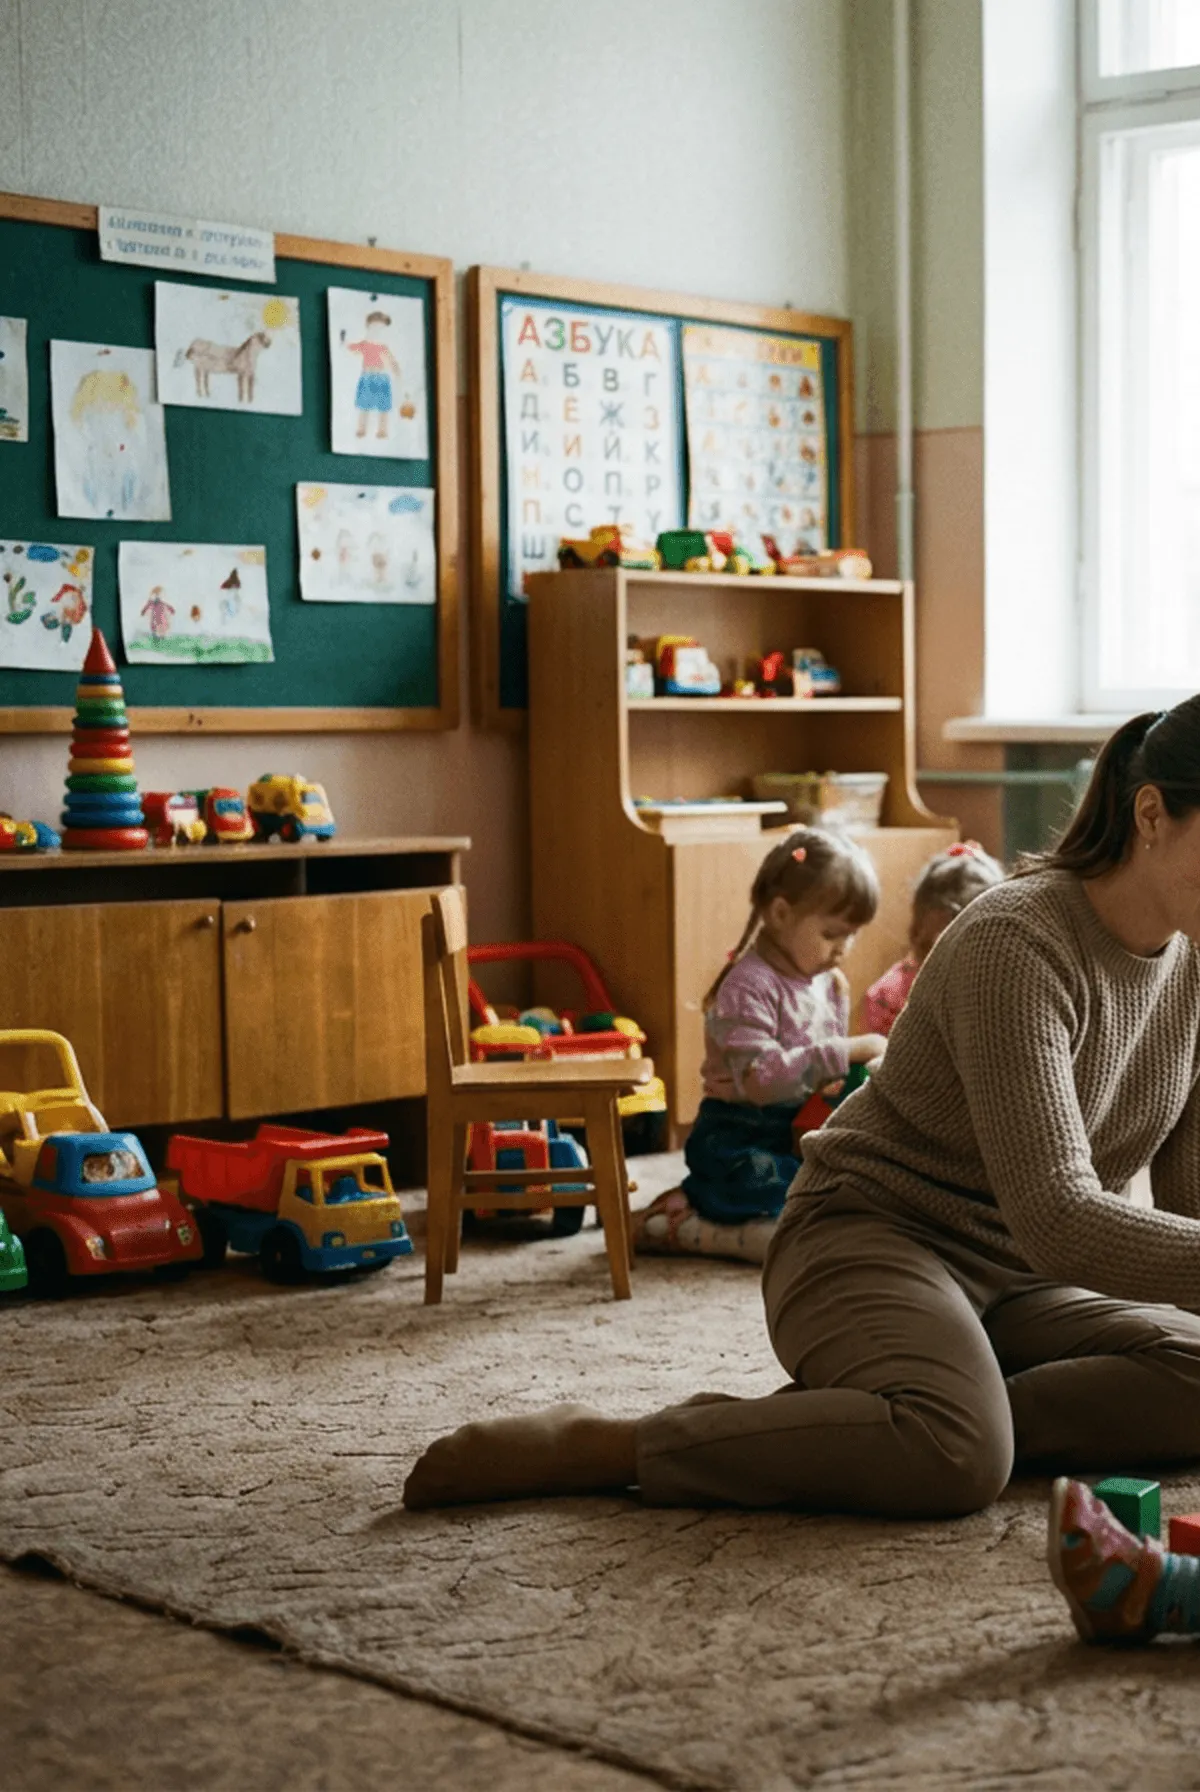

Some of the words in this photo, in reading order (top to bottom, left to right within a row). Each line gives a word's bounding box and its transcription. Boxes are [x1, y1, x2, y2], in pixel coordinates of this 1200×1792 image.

[517, 314, 661, 362] АЗБУКА
[520, 358, 538, 383] А
[562, 363, 581, 388] Б
[603, 368, 621, 392] В
[644, 372, 657, 397] Г
[520, 393, 540, 421] Д
[599, 400, 625, 428] Ж
[644, 405, 660, 430] З
[522, 430, 539, 454] И
[563, 433, 582, 458] И
[604, 428, 621, 461] Й
[645, 441, 661, 464] К
[563, 467, 584, 493] О
[605, 471, 622, 496] П
[646, 474, 661, 496] Р
[523, 499, 541, 525] П
[565, 503, 585, 527] С
[522, 532, 546, 560] Ш
